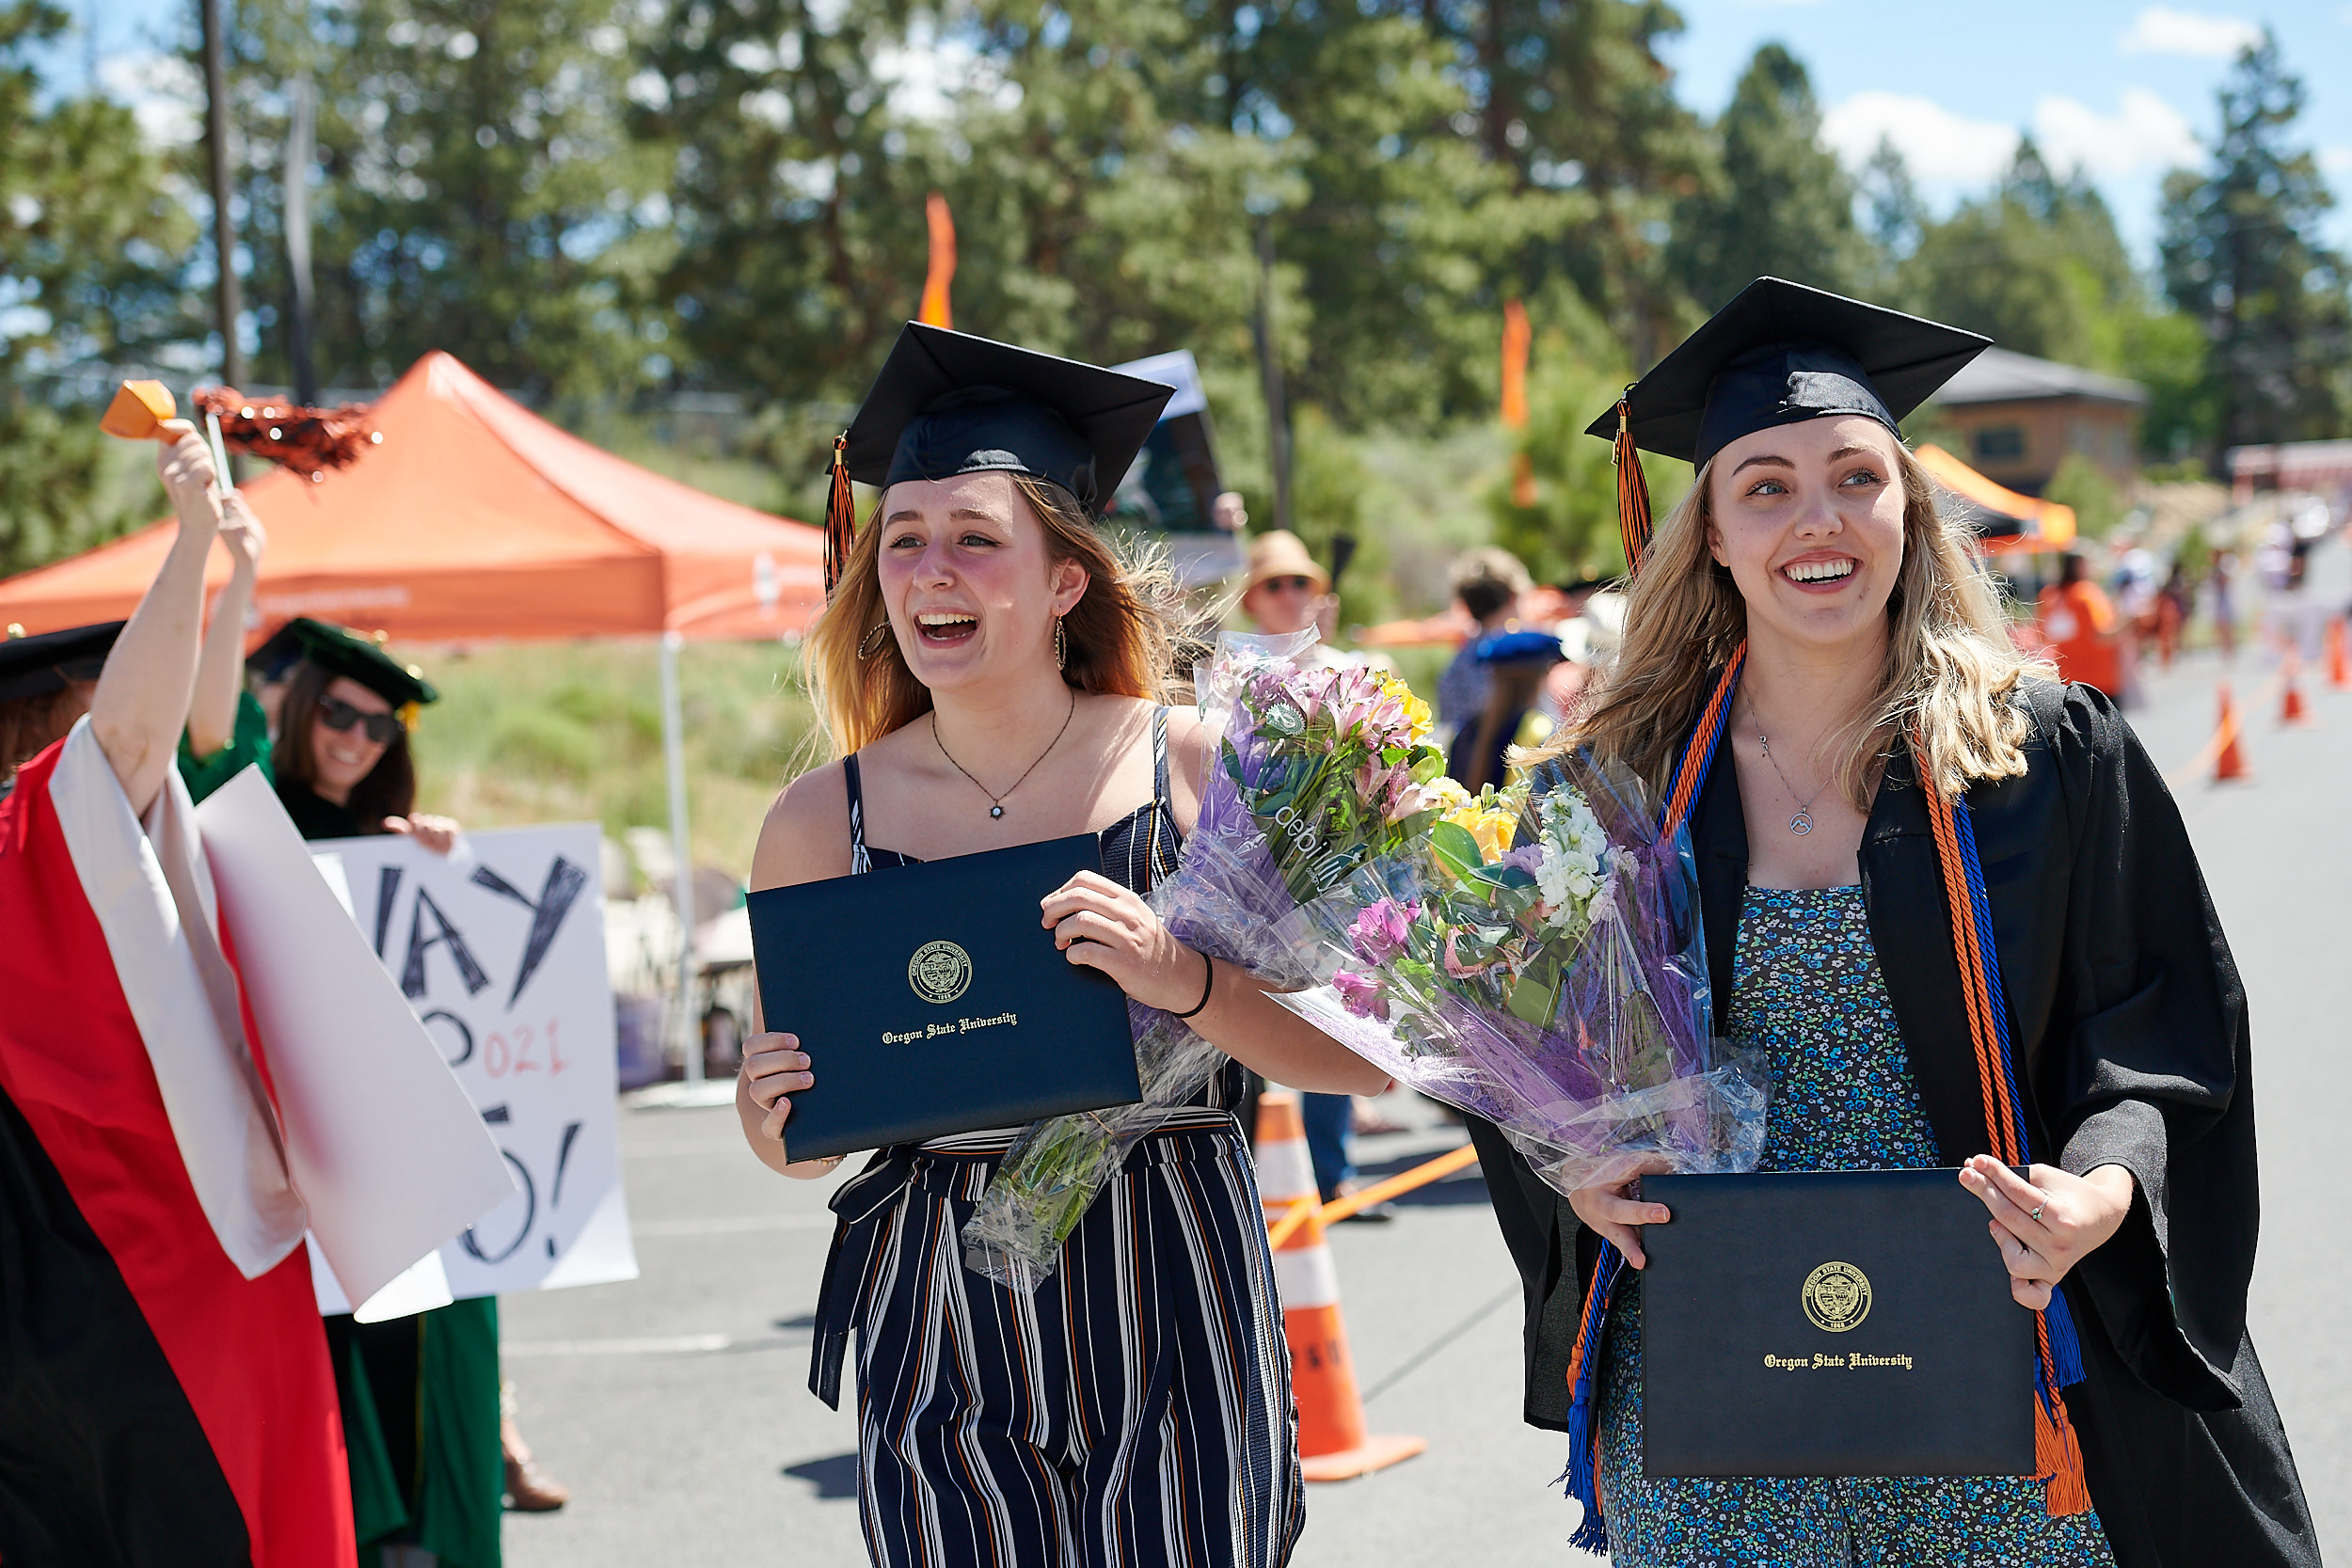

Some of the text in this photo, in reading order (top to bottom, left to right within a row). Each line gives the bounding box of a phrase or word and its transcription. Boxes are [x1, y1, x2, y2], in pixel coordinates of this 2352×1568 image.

[923, 943, 942, 954] STATE
[942, 943, 968, 968] UNIVERSITY
[882, 1011, 1018, 1045] Oregon State University
[1805, 1265, 1868, 1297] OREGON STATE UNIVERSITY
[1763, 1352, 1914, 1371] Oregon State University
